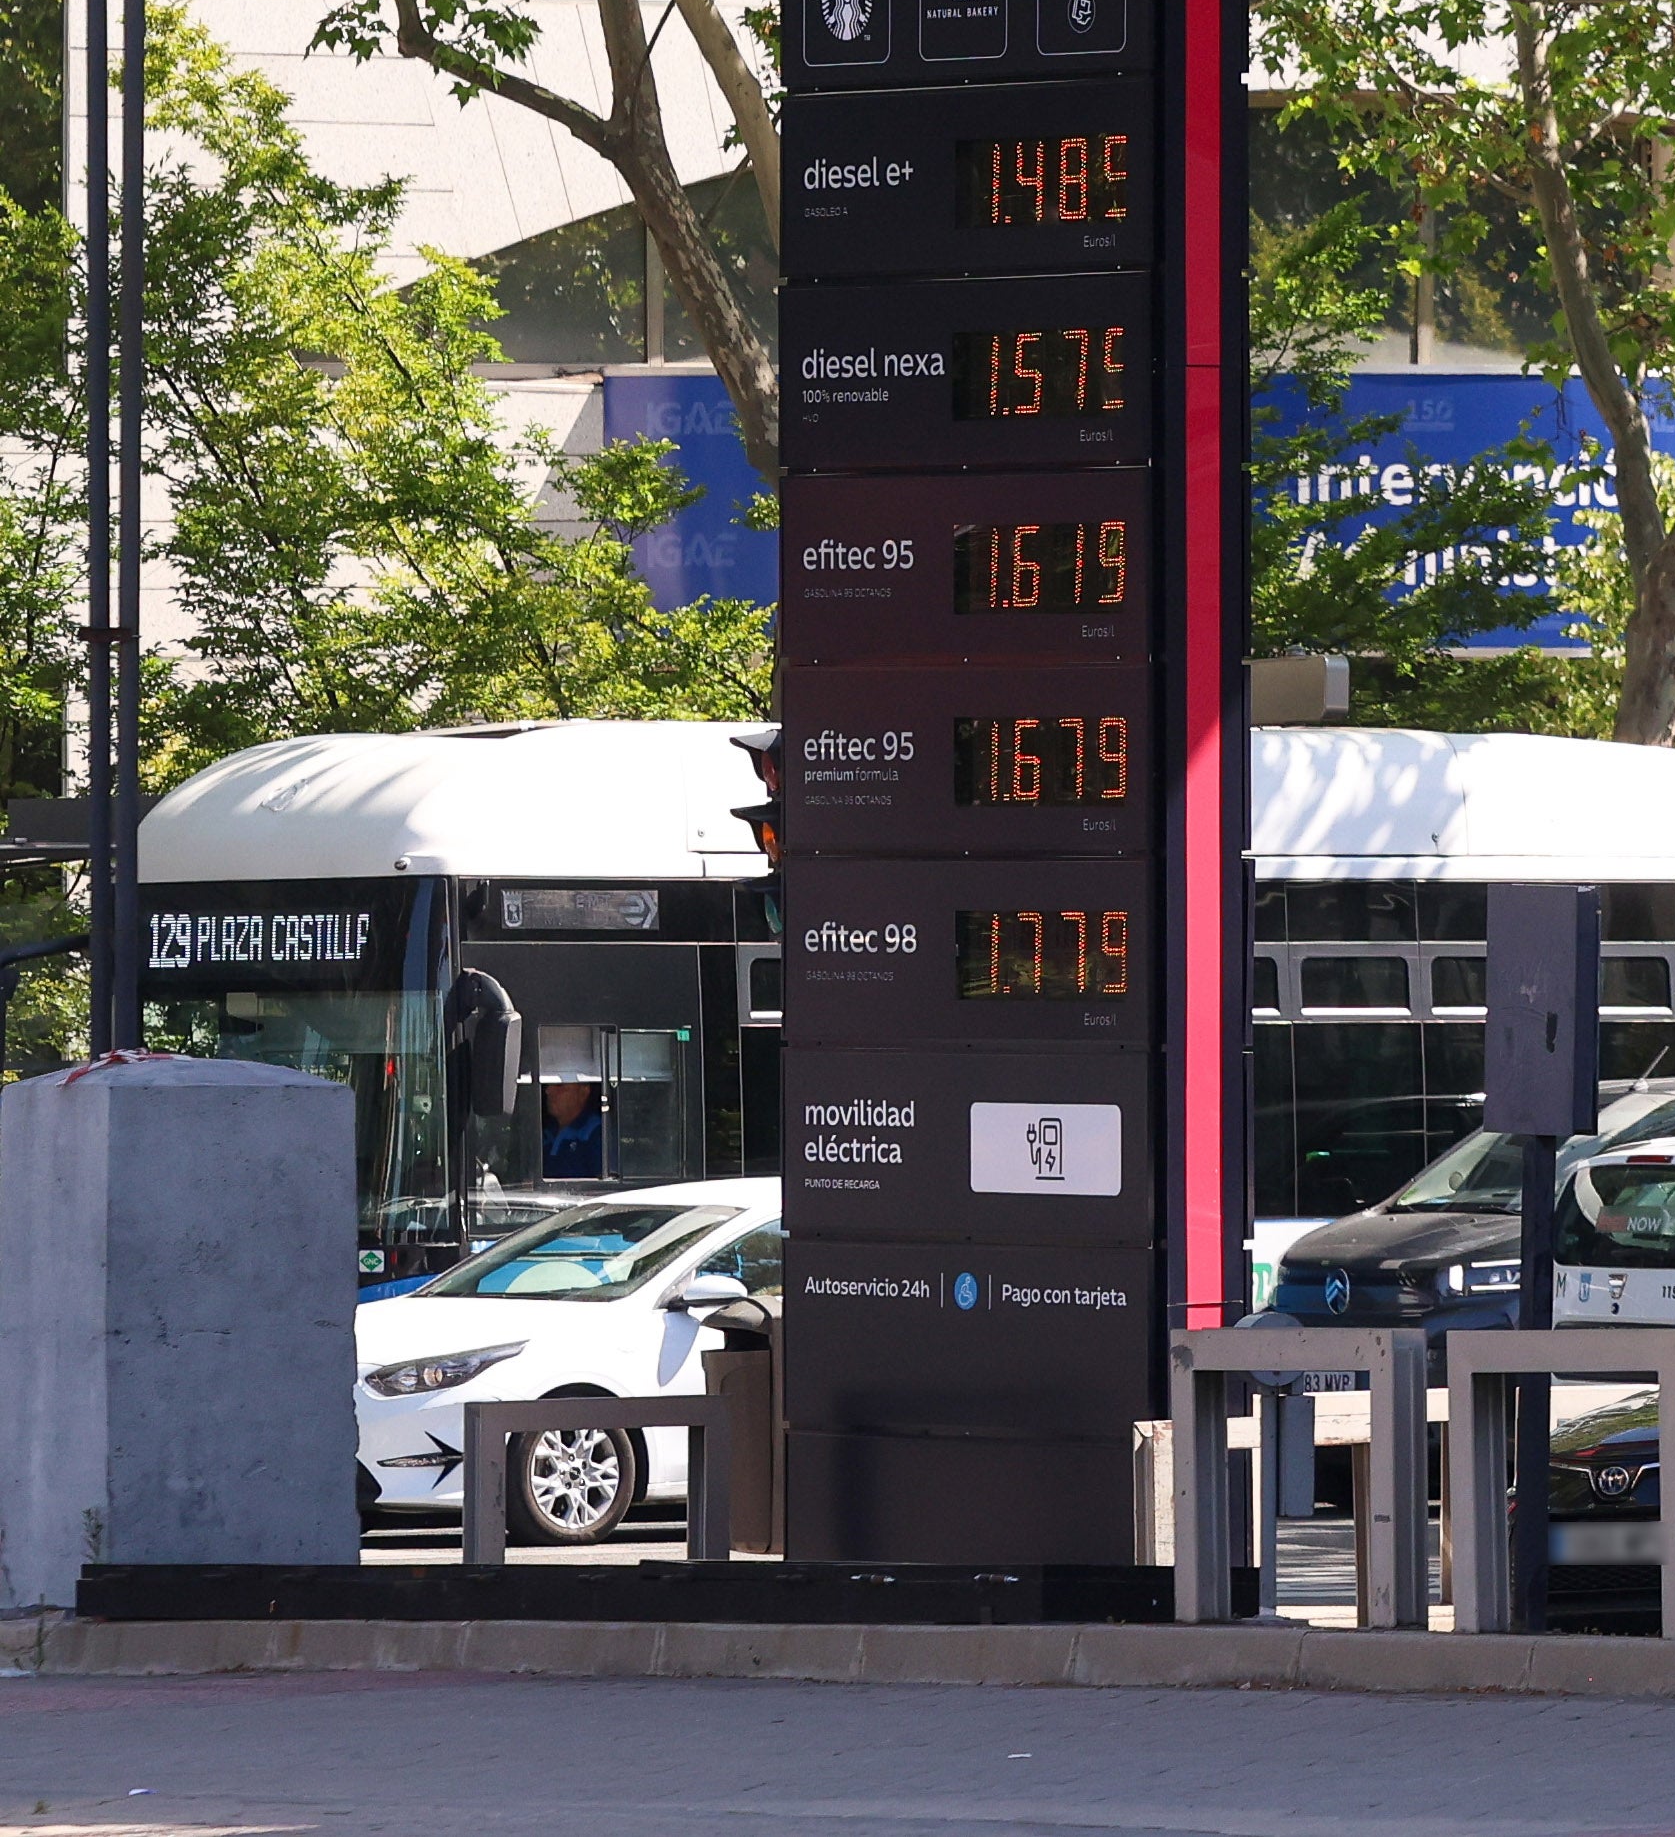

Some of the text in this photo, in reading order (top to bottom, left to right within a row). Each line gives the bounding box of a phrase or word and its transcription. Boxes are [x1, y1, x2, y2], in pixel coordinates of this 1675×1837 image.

[927, 6, 999, 19] NATURAL BAKERY
[804, 156, 914, 190] diesel e+
[802, 347, 945, 379] diesel nexa
[802, 388, 889, 403] 100% renovable
[803, 540, 914, 570] efitec 95
[989, 521, 1126, 608] 1.619
[804, 730, 914, 761] efitec 95
[990, 717, 1127, 801] 1.679
[149, 914, 191, 968] 129
[197, 915, 263, 961] PLAZA
[805, 922, 917, 954] efitec 98
[990, 911, 1128, 994] 1.779
[805, 1099, 915, 1128] movilidad
[804, 1136, 902, 1164] eléctrica
[805, 1178, 880, 1190] PUNTO DE RECARGA
[1626, 1216, 1662, 1232] NOW
[363, 1257, 379, 1266] GNC
[804, 1276, 930, 1298] Autoservicio 24h
[1002, 1284, 1127, 1310] Pago con tarjeta
[1556, 1272, 1567, 1298] M
[1304, 1374, 1350, 1392] 83 MVP
